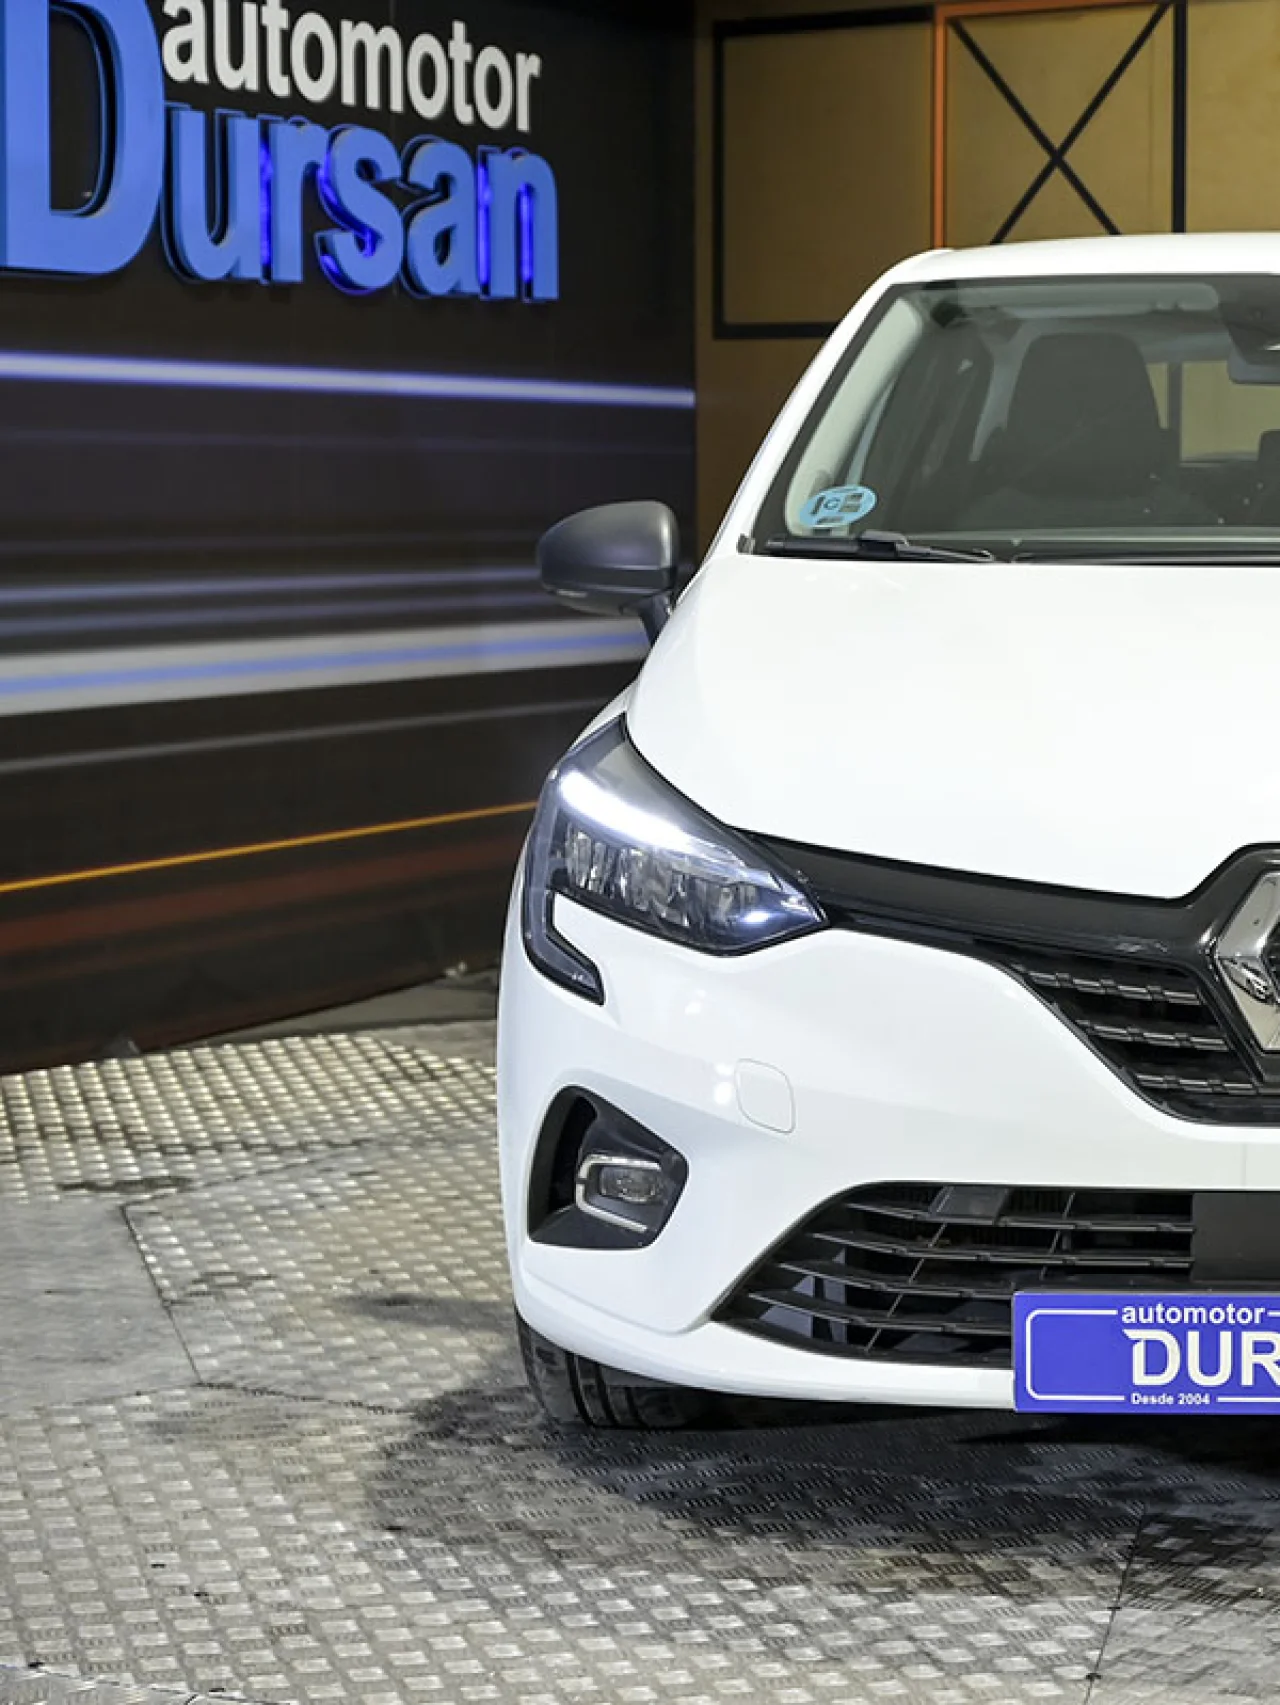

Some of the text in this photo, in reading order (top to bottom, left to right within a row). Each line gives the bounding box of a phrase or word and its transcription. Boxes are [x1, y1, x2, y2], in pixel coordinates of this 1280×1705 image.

[163, 0, 541, 132] automotor
[0, 0, 559, 301] Dursan
[1121, 1303, 1266, 1324] automotor
[1131, 1393, 1211, 1404] Desde 2004
